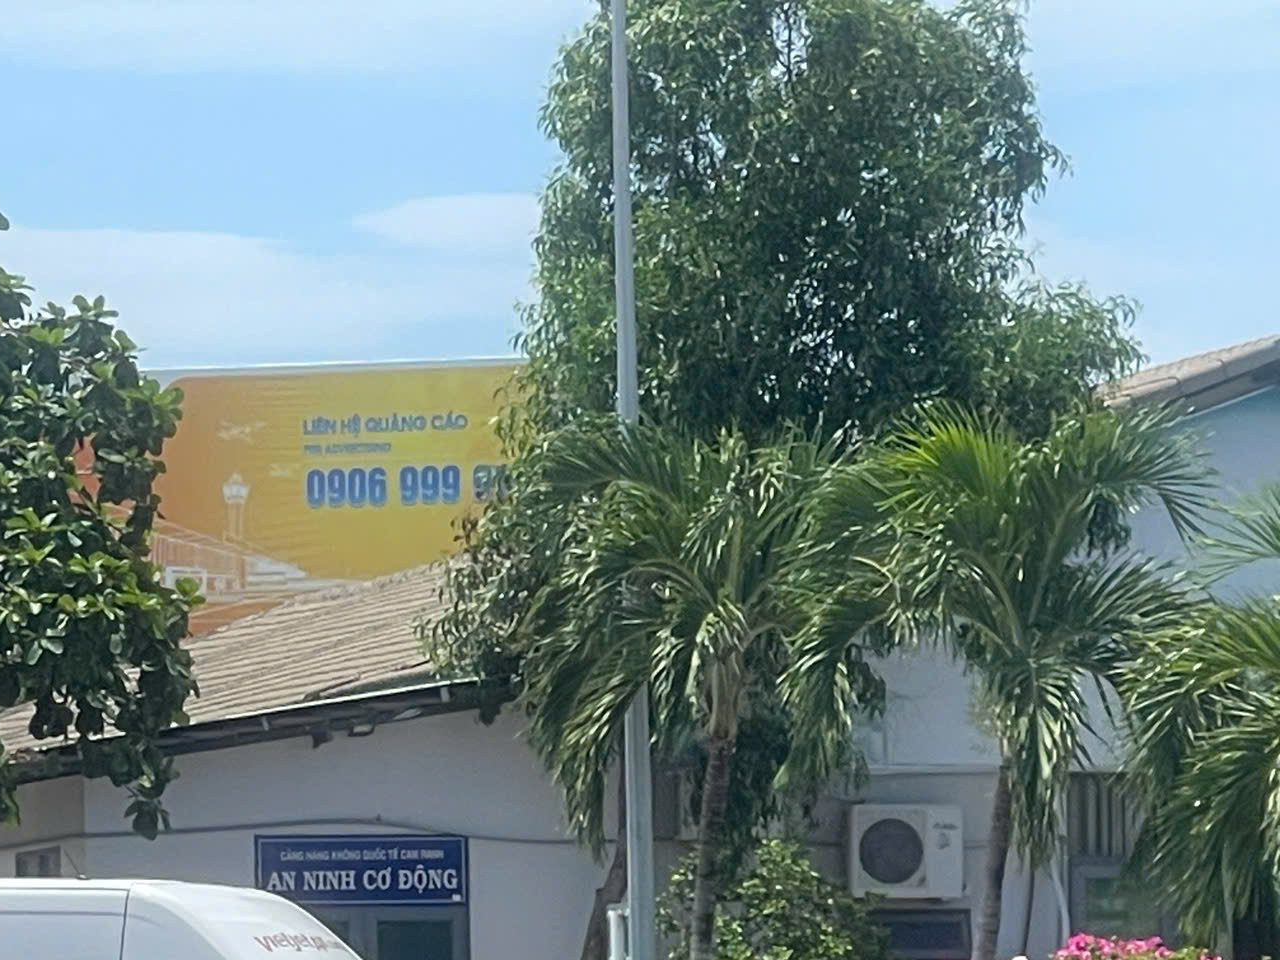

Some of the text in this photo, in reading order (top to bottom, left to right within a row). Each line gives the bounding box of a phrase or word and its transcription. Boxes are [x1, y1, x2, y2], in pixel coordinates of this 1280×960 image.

[431, 410, 468, 431] CÁO
[306, 466, 387, 509] 0906
[399, 464, 461, 505] 999
[267, 864, 458, 894] AN NINH CƠ ĐỘNG
